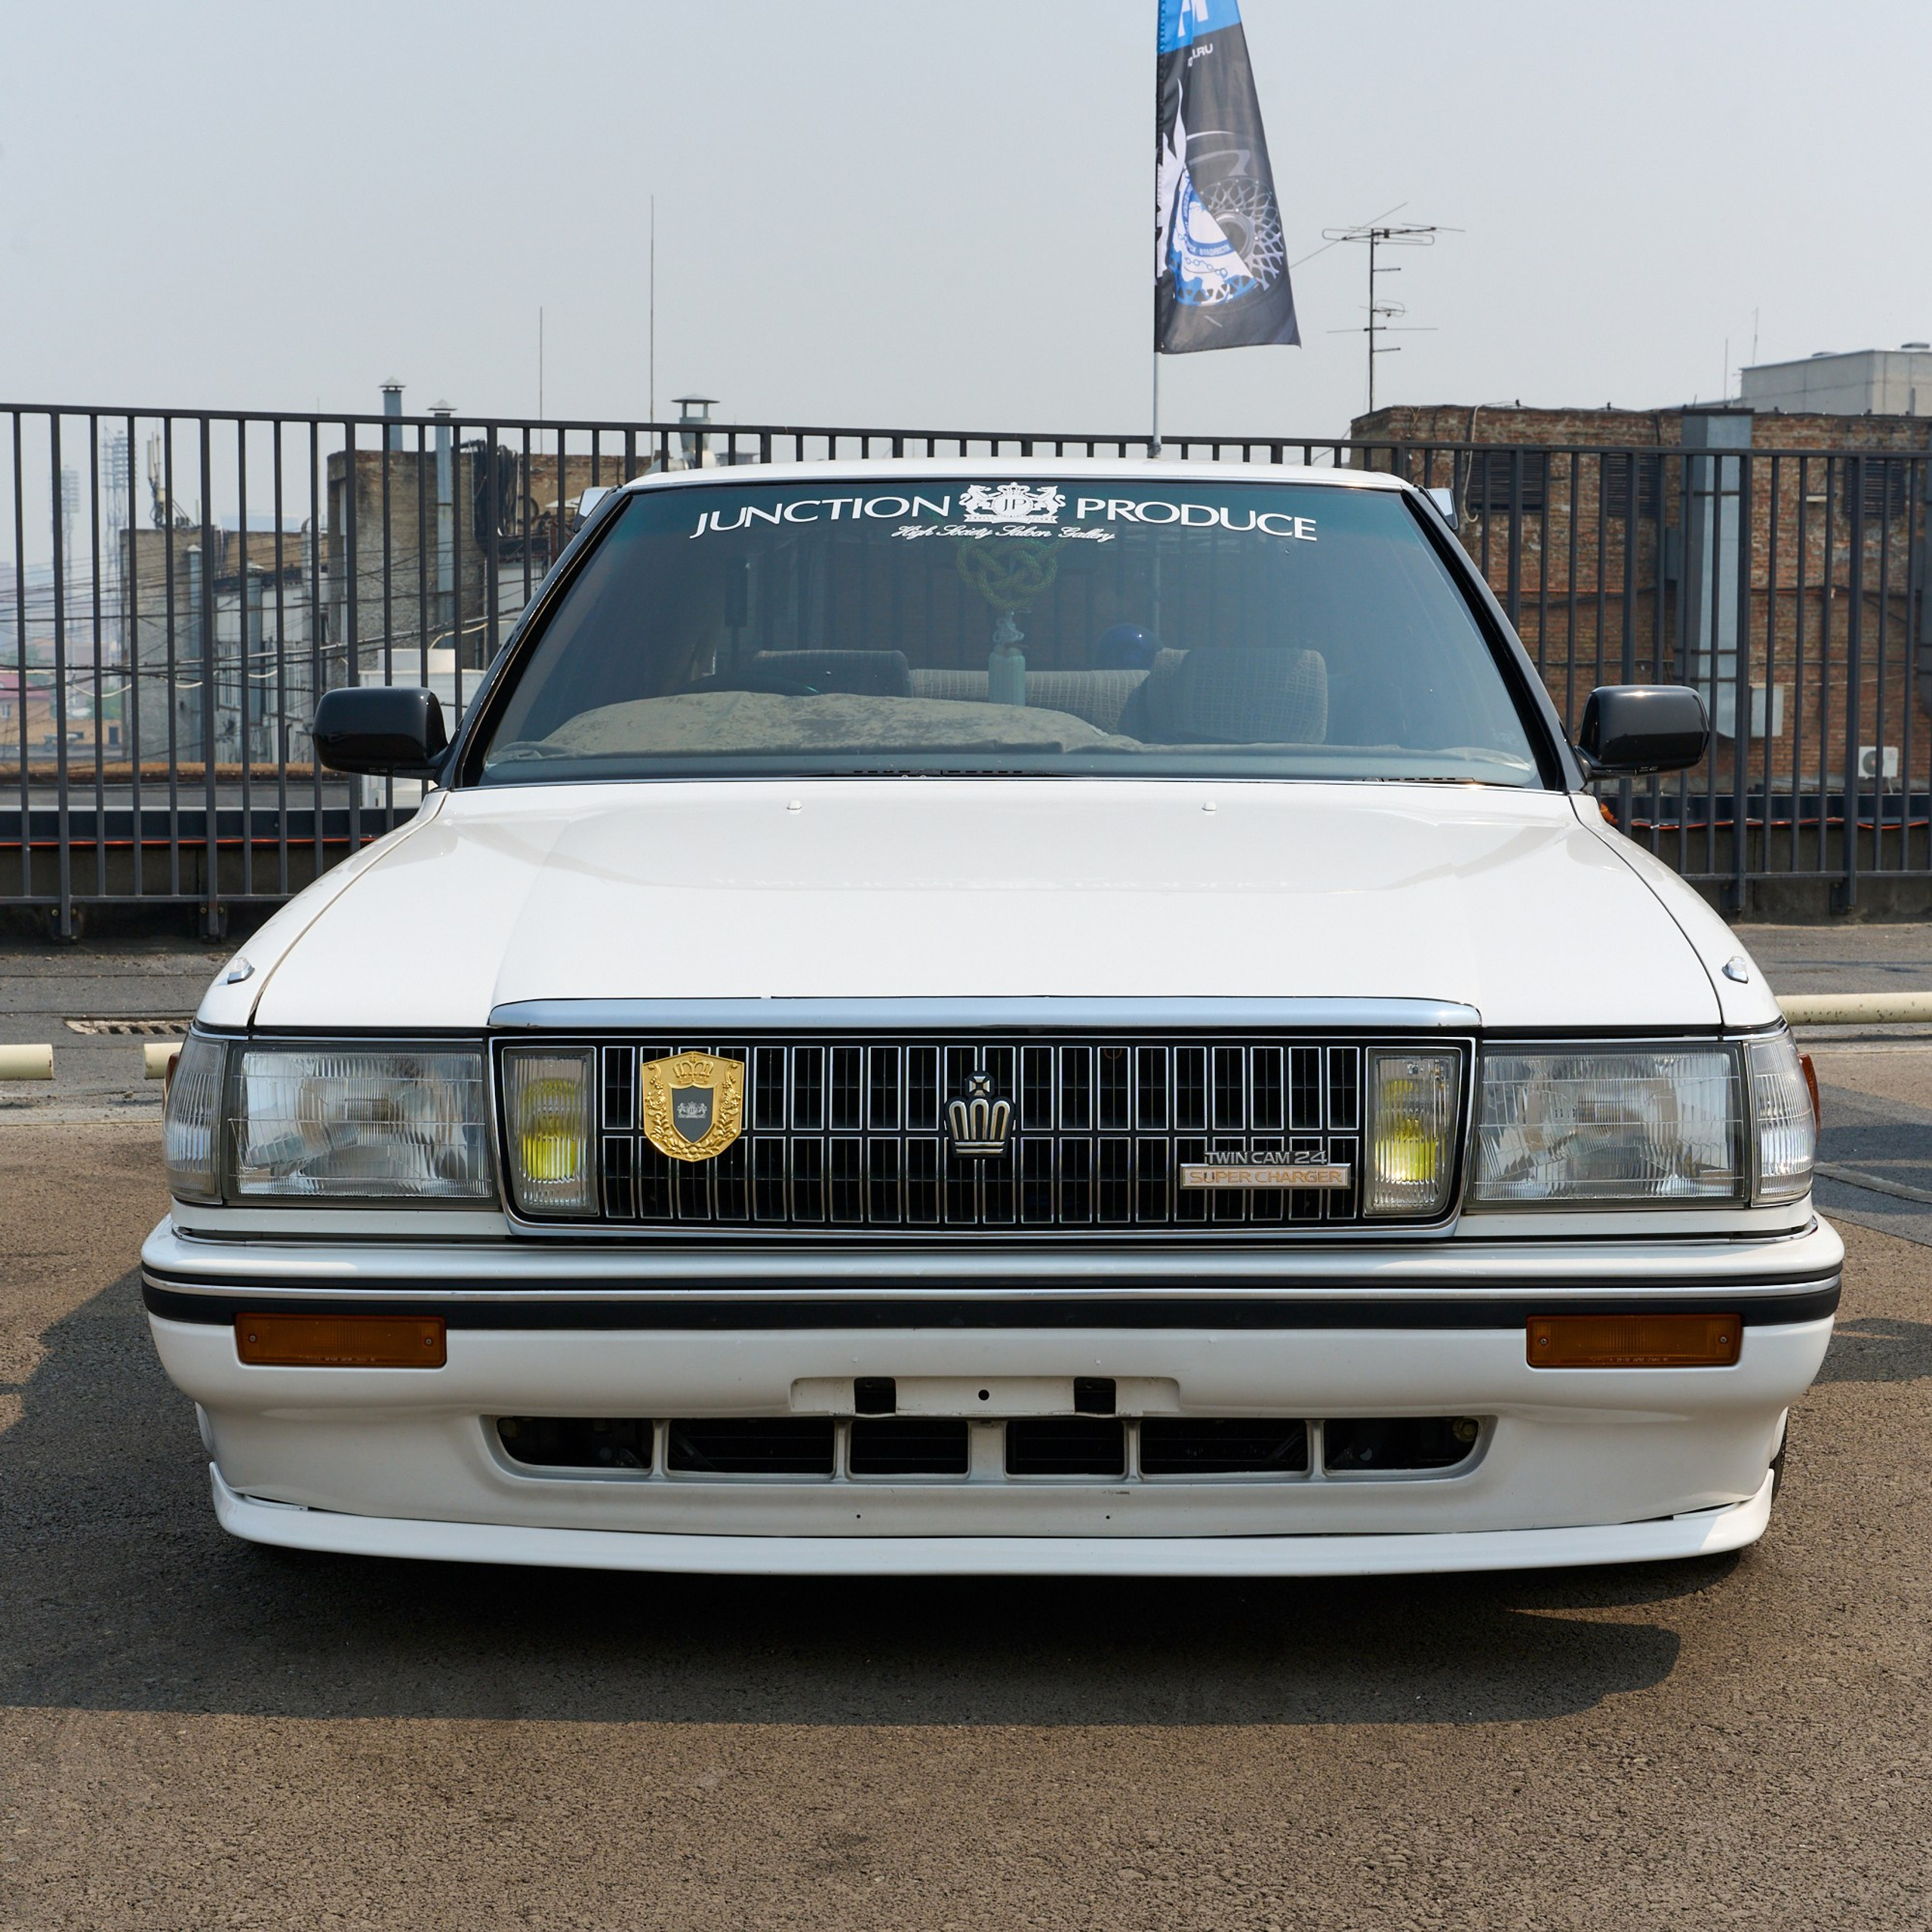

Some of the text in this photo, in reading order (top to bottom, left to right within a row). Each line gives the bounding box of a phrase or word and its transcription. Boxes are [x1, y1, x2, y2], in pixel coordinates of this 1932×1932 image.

[1002, 498, 1027, 512] JP
[690, 495, 1317, 541] JUNCTION PRODUCE
[891, 525, 934, 540] High
[936, 524, 993, 540] Society
[1057, 526, 1116, 543] Gallery
[1204, 1151, 1327, 1164] TWIN CAM 24
[1189, 1171, 1342, 1183] SUPER CHARGER
